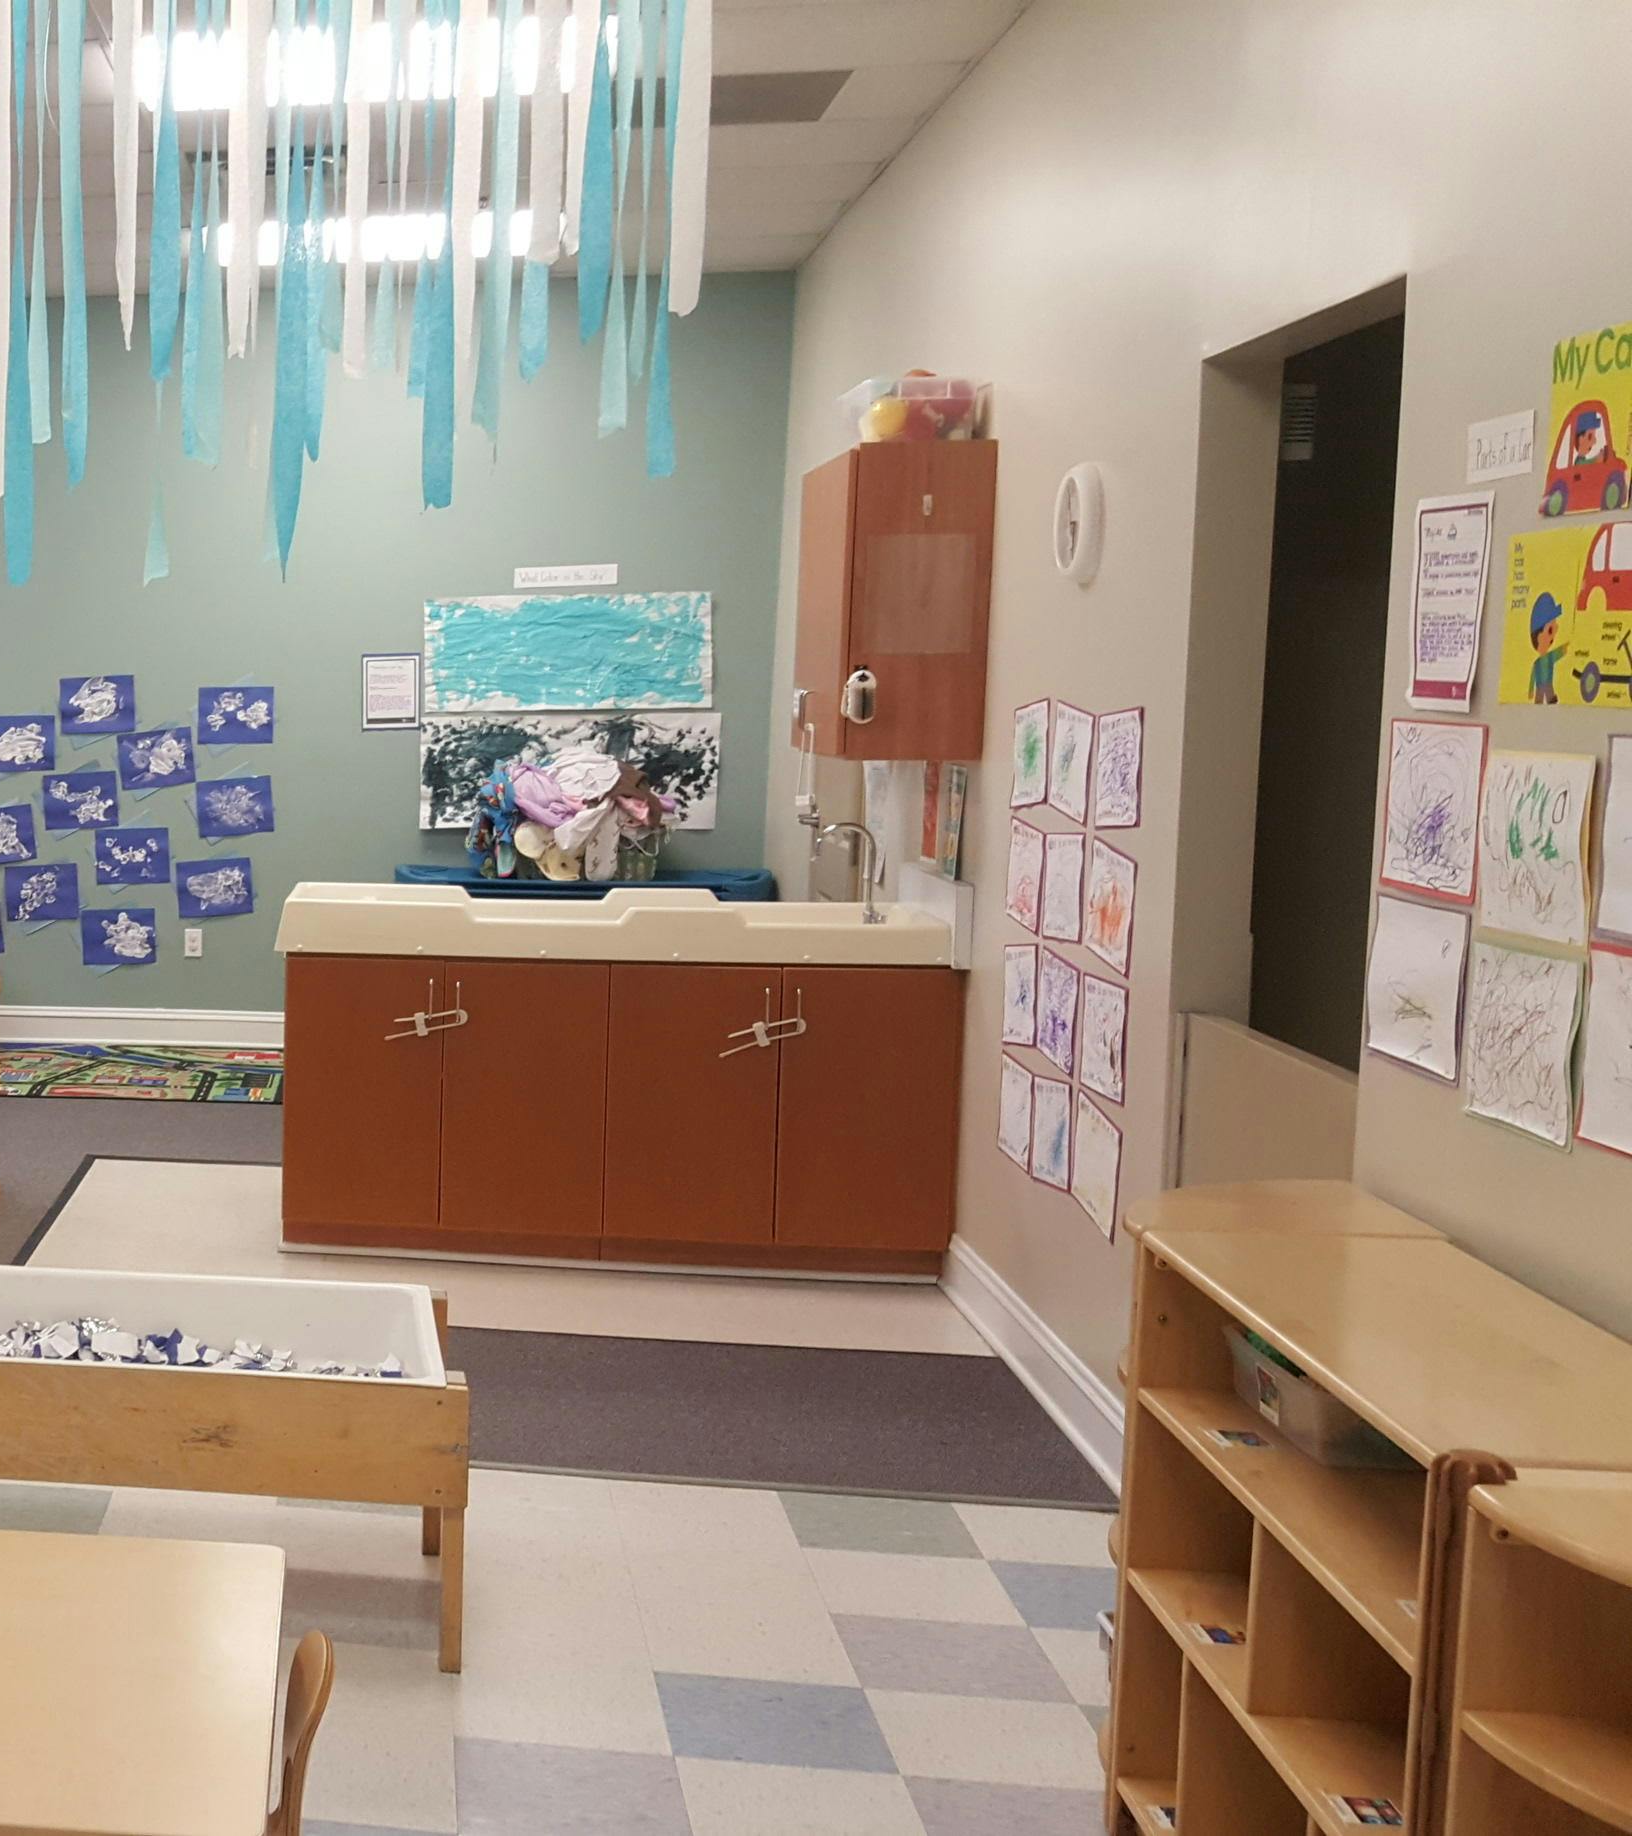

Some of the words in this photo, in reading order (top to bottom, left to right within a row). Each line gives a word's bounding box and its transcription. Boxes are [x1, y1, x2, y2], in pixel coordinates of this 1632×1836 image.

[1553, 336, 1591, 390] My
[1476, 438, 1496, 470] Parts
[1499, 432, 1508, 465] of
